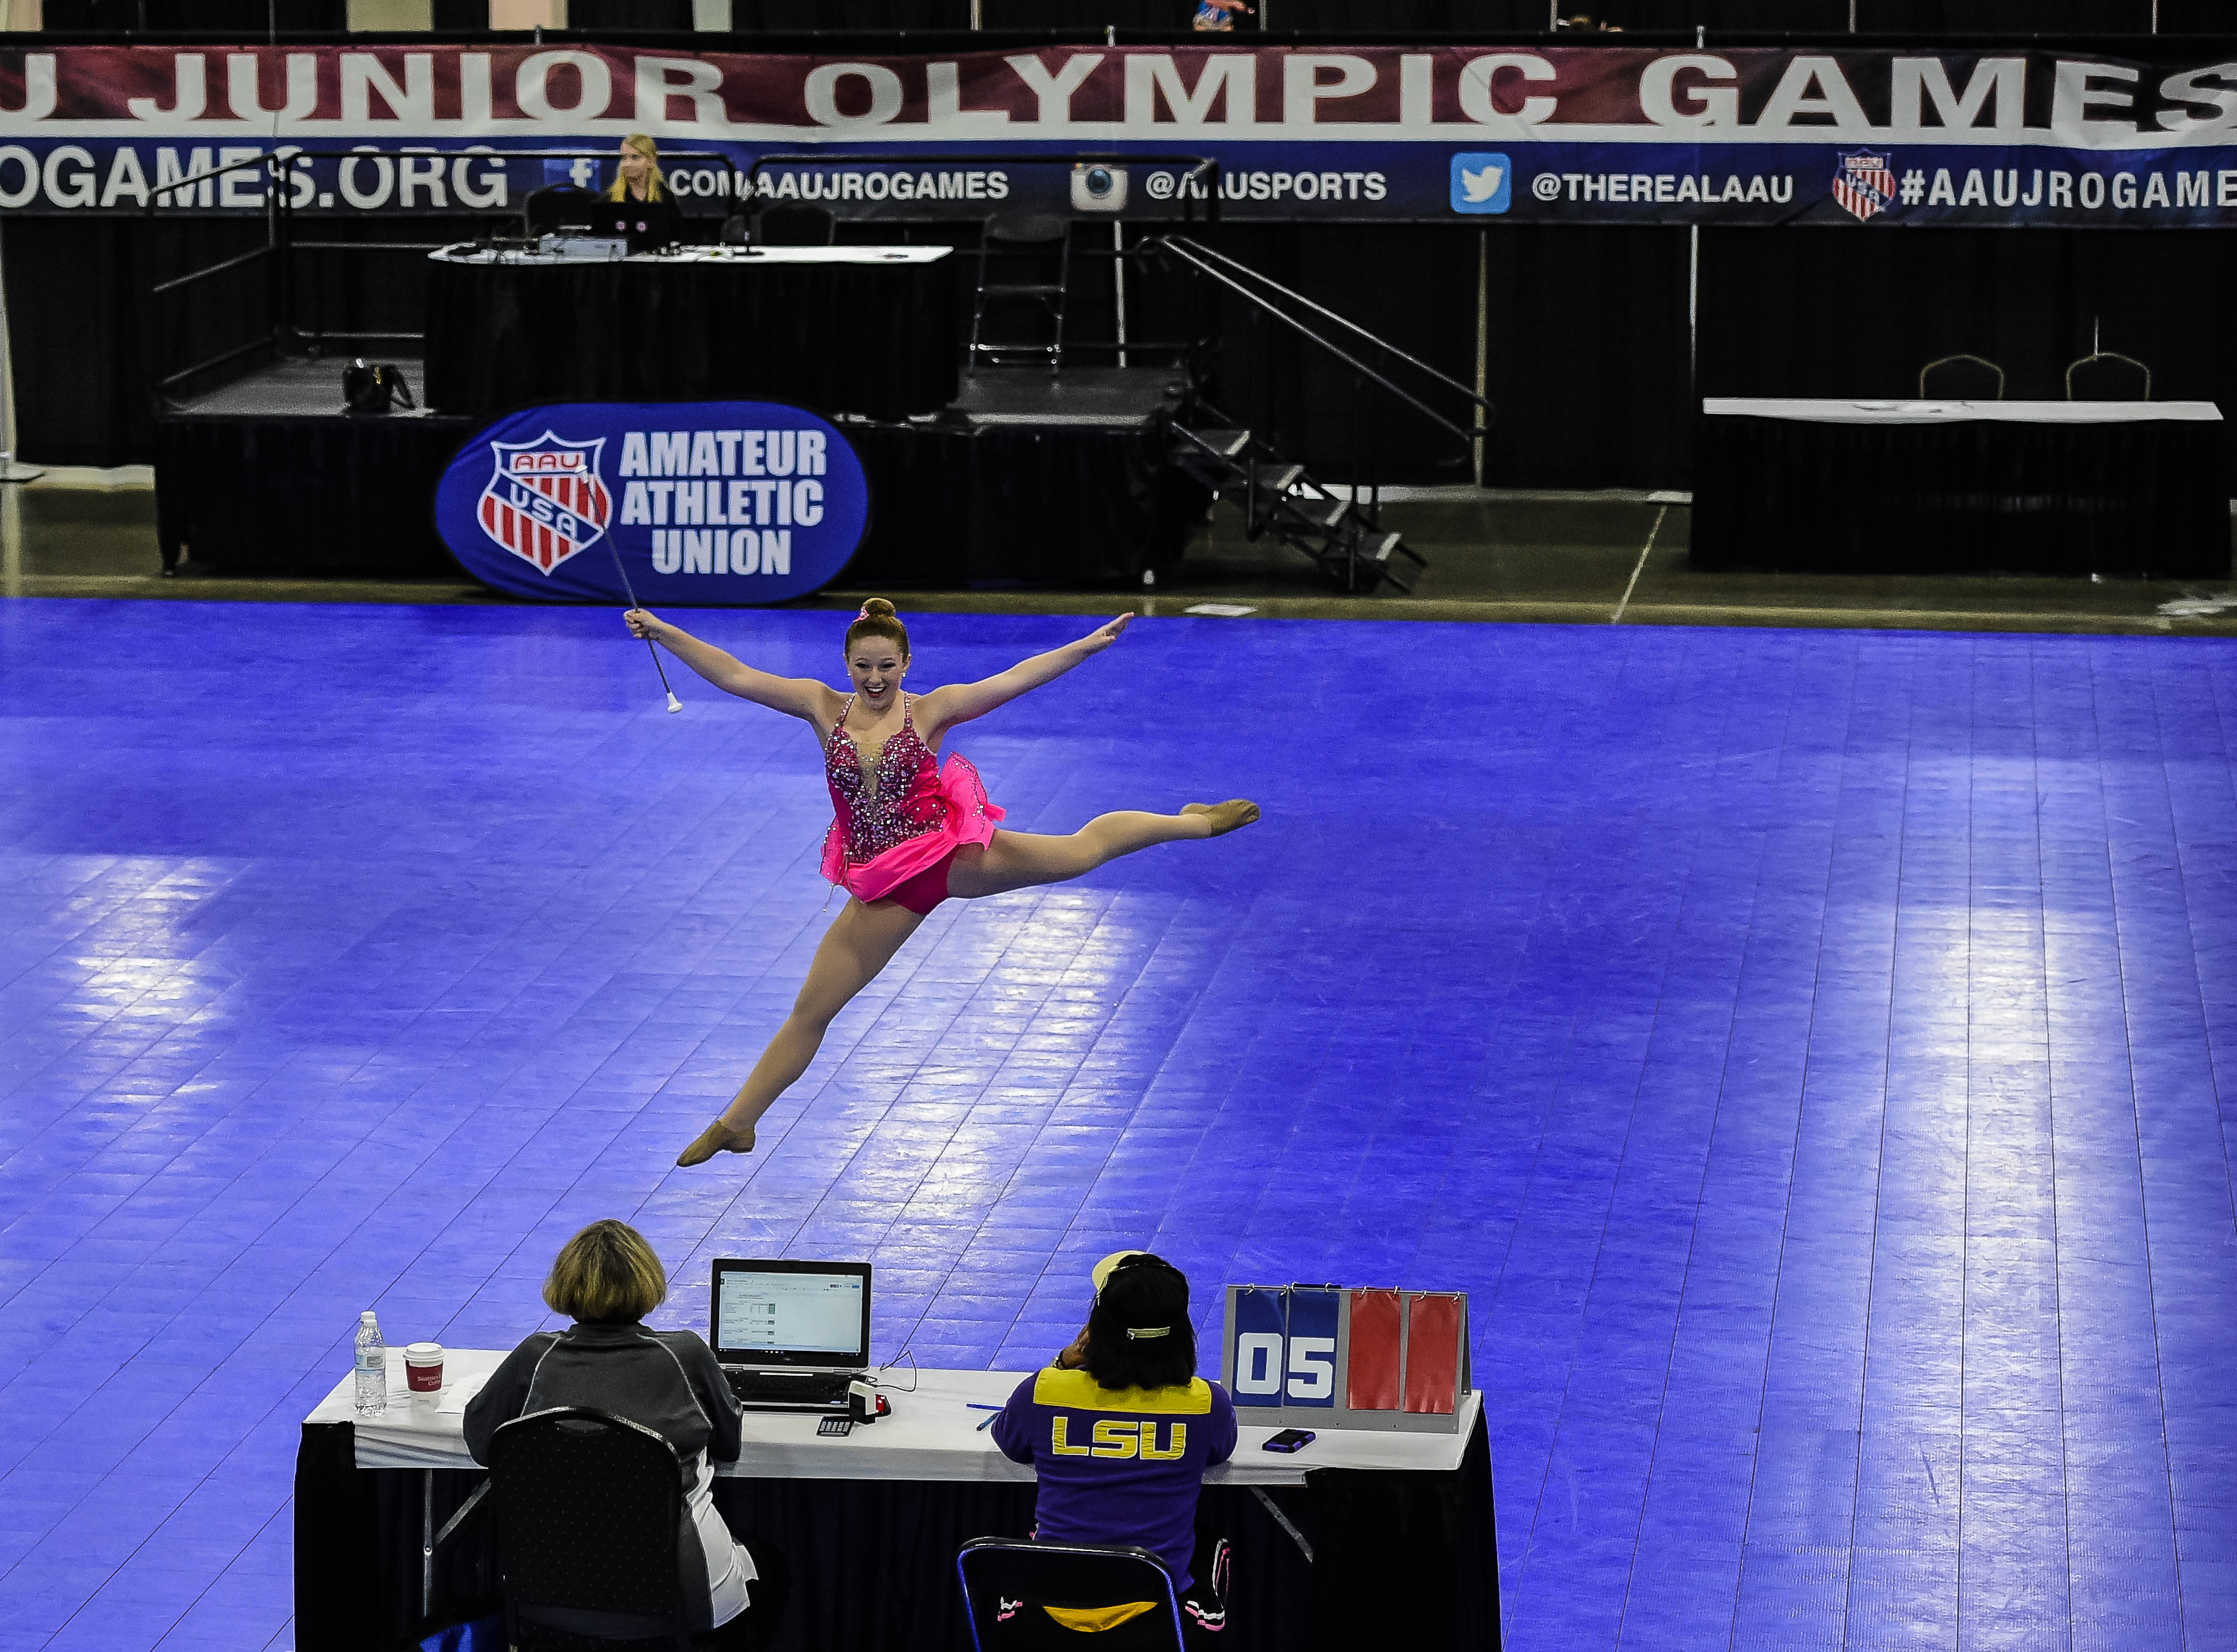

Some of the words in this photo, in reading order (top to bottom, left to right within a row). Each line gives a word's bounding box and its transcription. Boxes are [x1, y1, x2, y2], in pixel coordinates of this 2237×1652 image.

[127, 50, 728, 122] JUNIOR
[804, 53, 1558, 125] OLYMPIC
[1639, 54, 2237, 133] GAMES
[1533, 173, 1793, 202] @THEREALAAU
[1900, 168, 2237, 209] #AAUJROGAME
[514, 454, 580, 470] AAU
[619, 430, 826, 476] AMATEUR
[511, 483, 577, 536] USA
[620, 480, 824, 527] ATHLETIC
[652, 529, 791, 575] UNION
[1052, 1417, 1186, 1460] LSU
